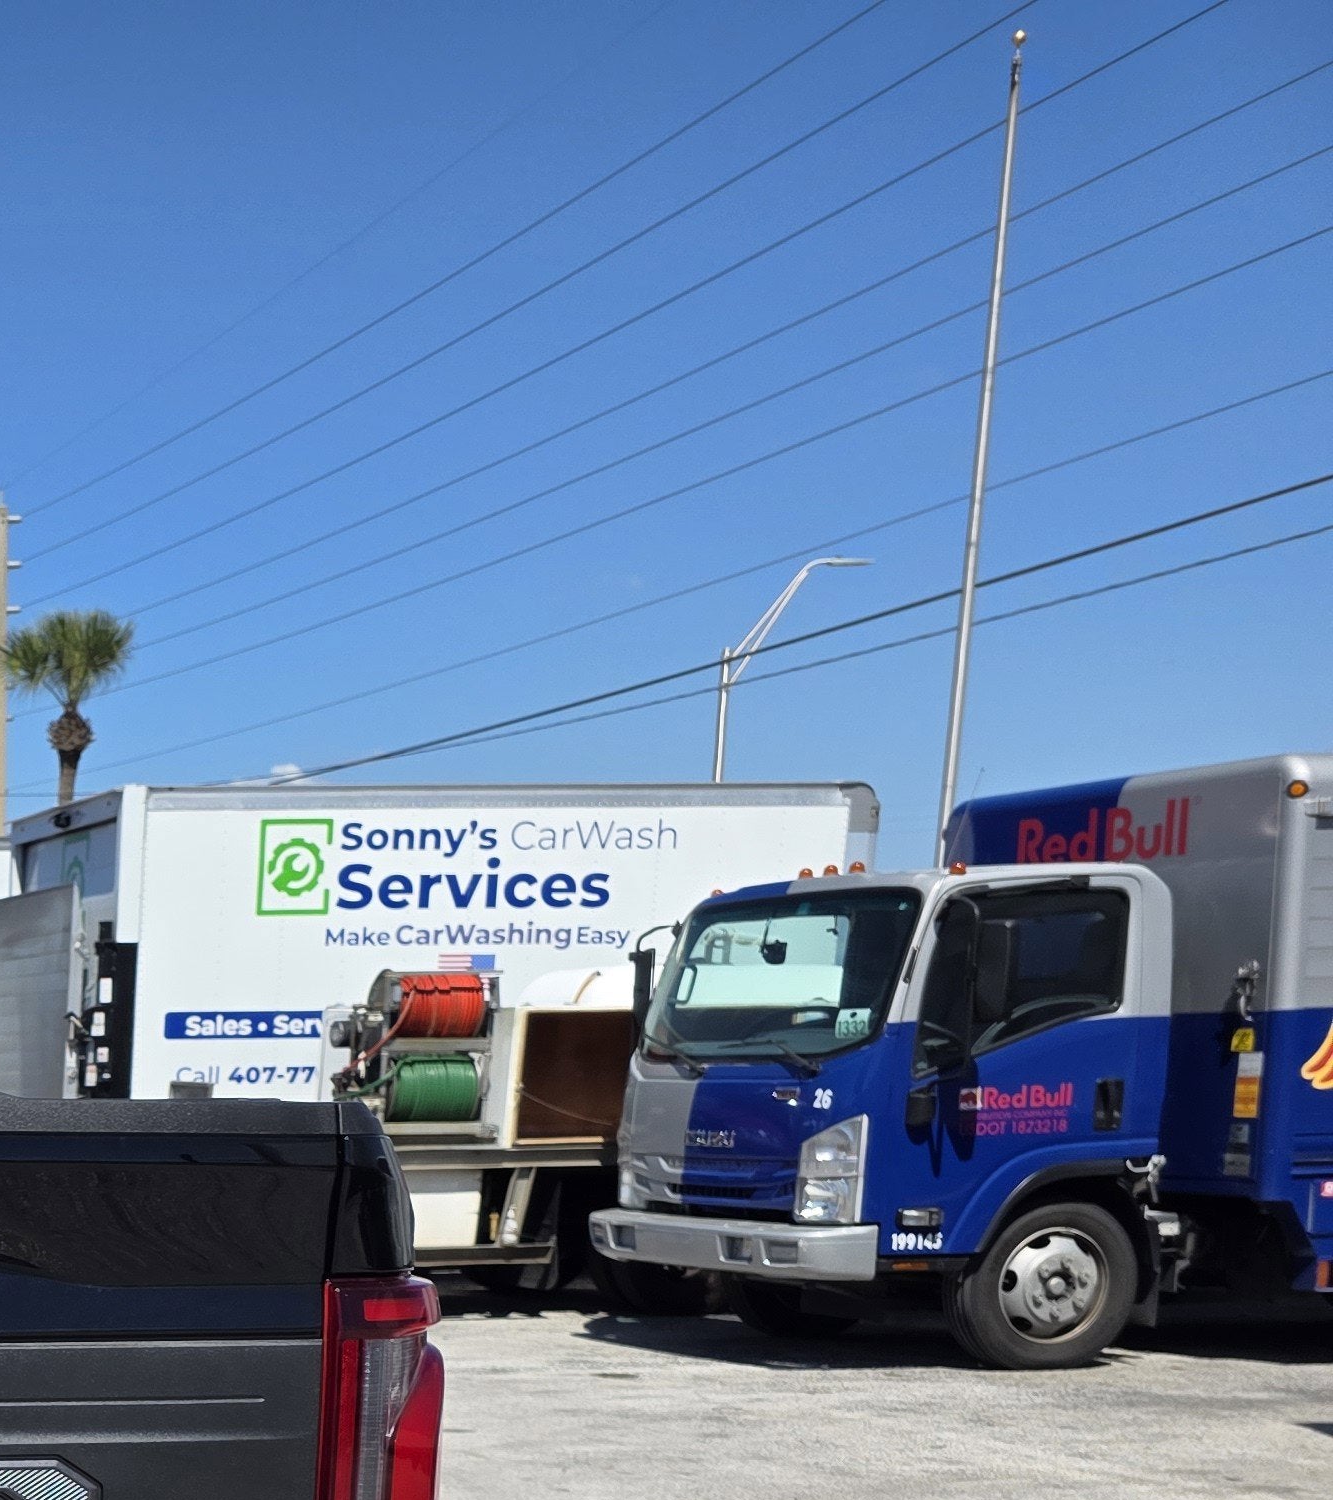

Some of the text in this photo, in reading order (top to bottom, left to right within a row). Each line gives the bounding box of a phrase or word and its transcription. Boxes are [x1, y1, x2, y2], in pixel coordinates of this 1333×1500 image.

[341, 819, 678, 857] Sonny's CarWash
[1017, 797, 1190, 863] Red Bull
[336, 857, 611, 910] Services
[325, 922, 630, 949] Make CarWashing Easy
[185, 1014, 252, 1036] Sales
[176, 1066, 315, 1084] Call 407-77
[813, 1088, 833, 1109] 26
[984, 1082, 1073, 1109] Red Bull
[962, 1120, 1006, 1136] DOT
